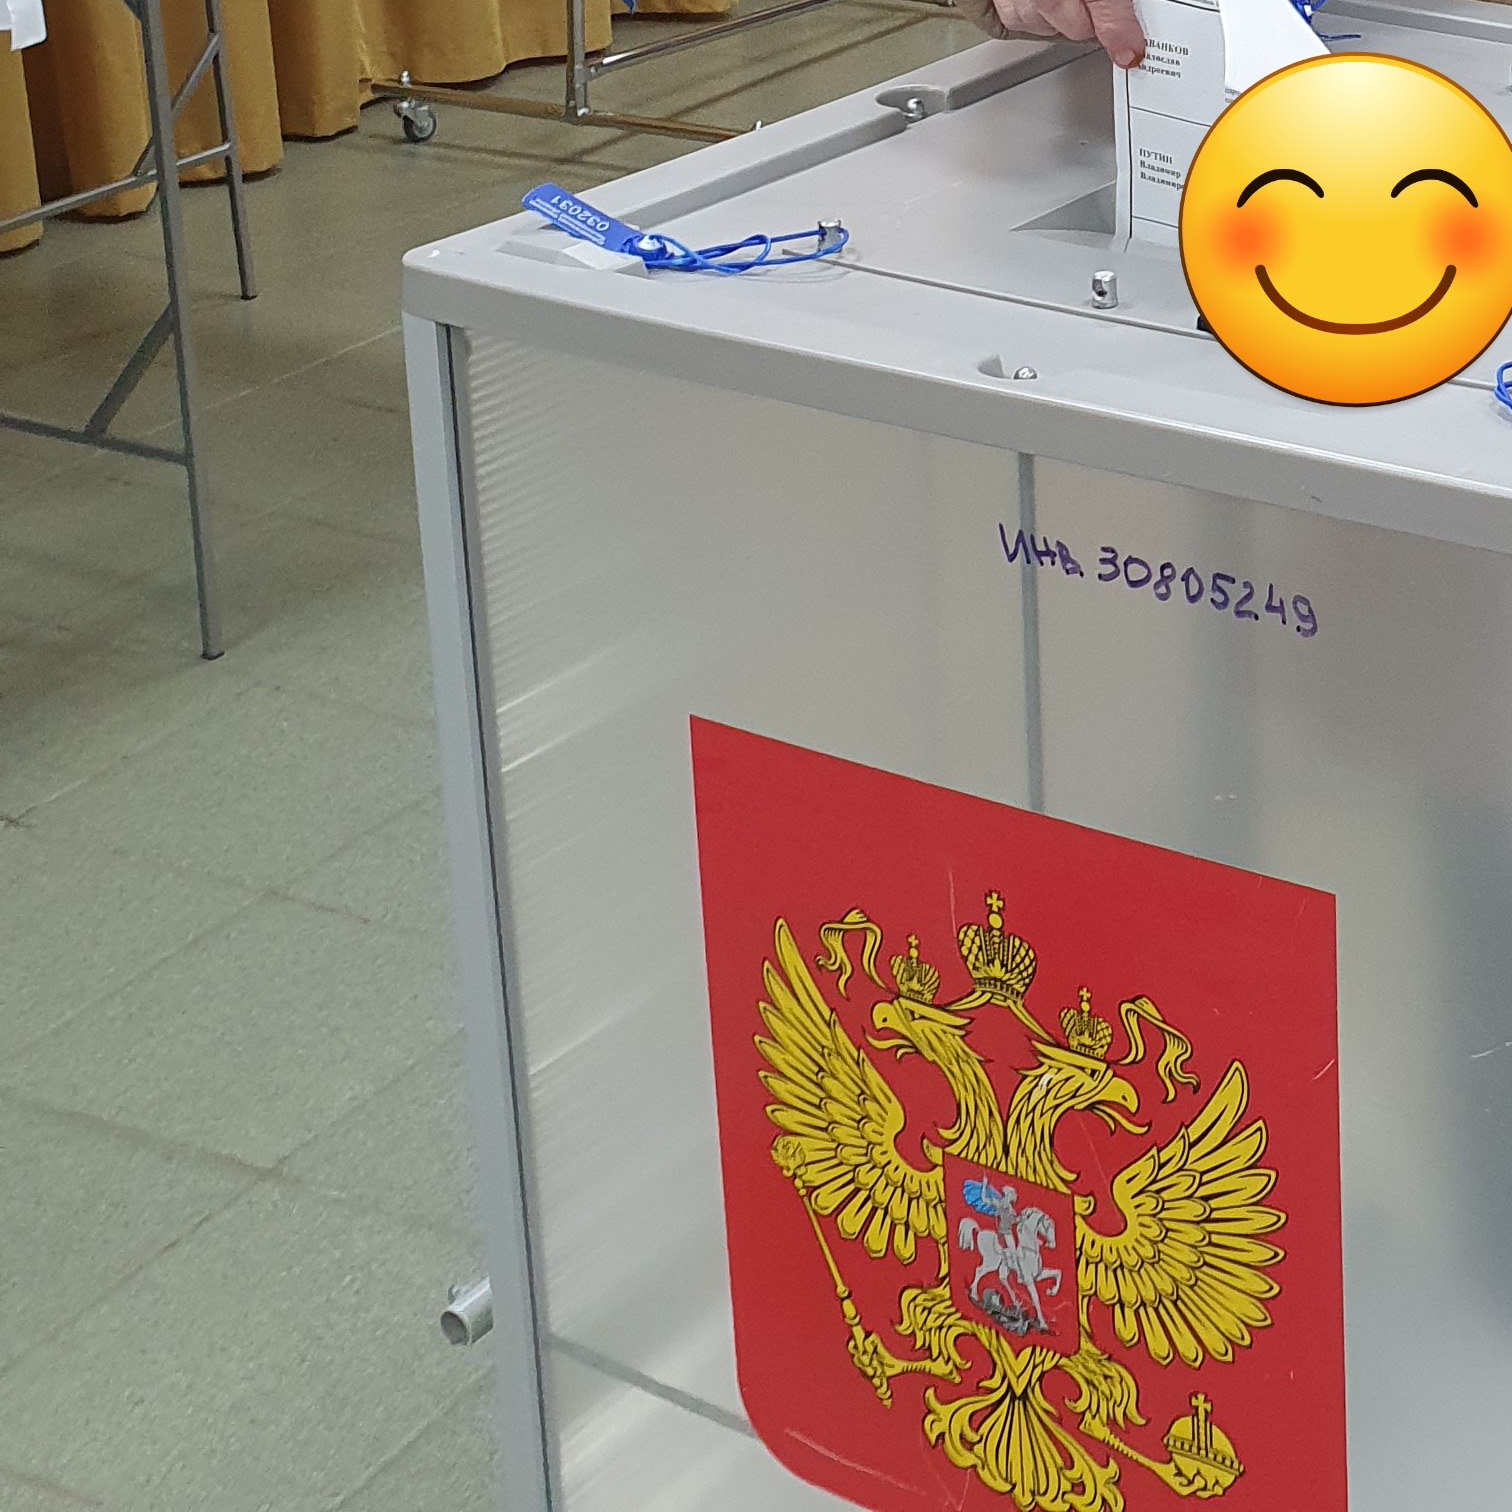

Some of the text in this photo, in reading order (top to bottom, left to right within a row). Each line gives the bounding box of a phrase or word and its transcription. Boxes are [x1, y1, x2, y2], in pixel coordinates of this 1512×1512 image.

[1139, 148, 1173, 164] ПУТИН
[549, 194, 611, 233] 032031
[1098, 546, 1319, 638] 30805249
